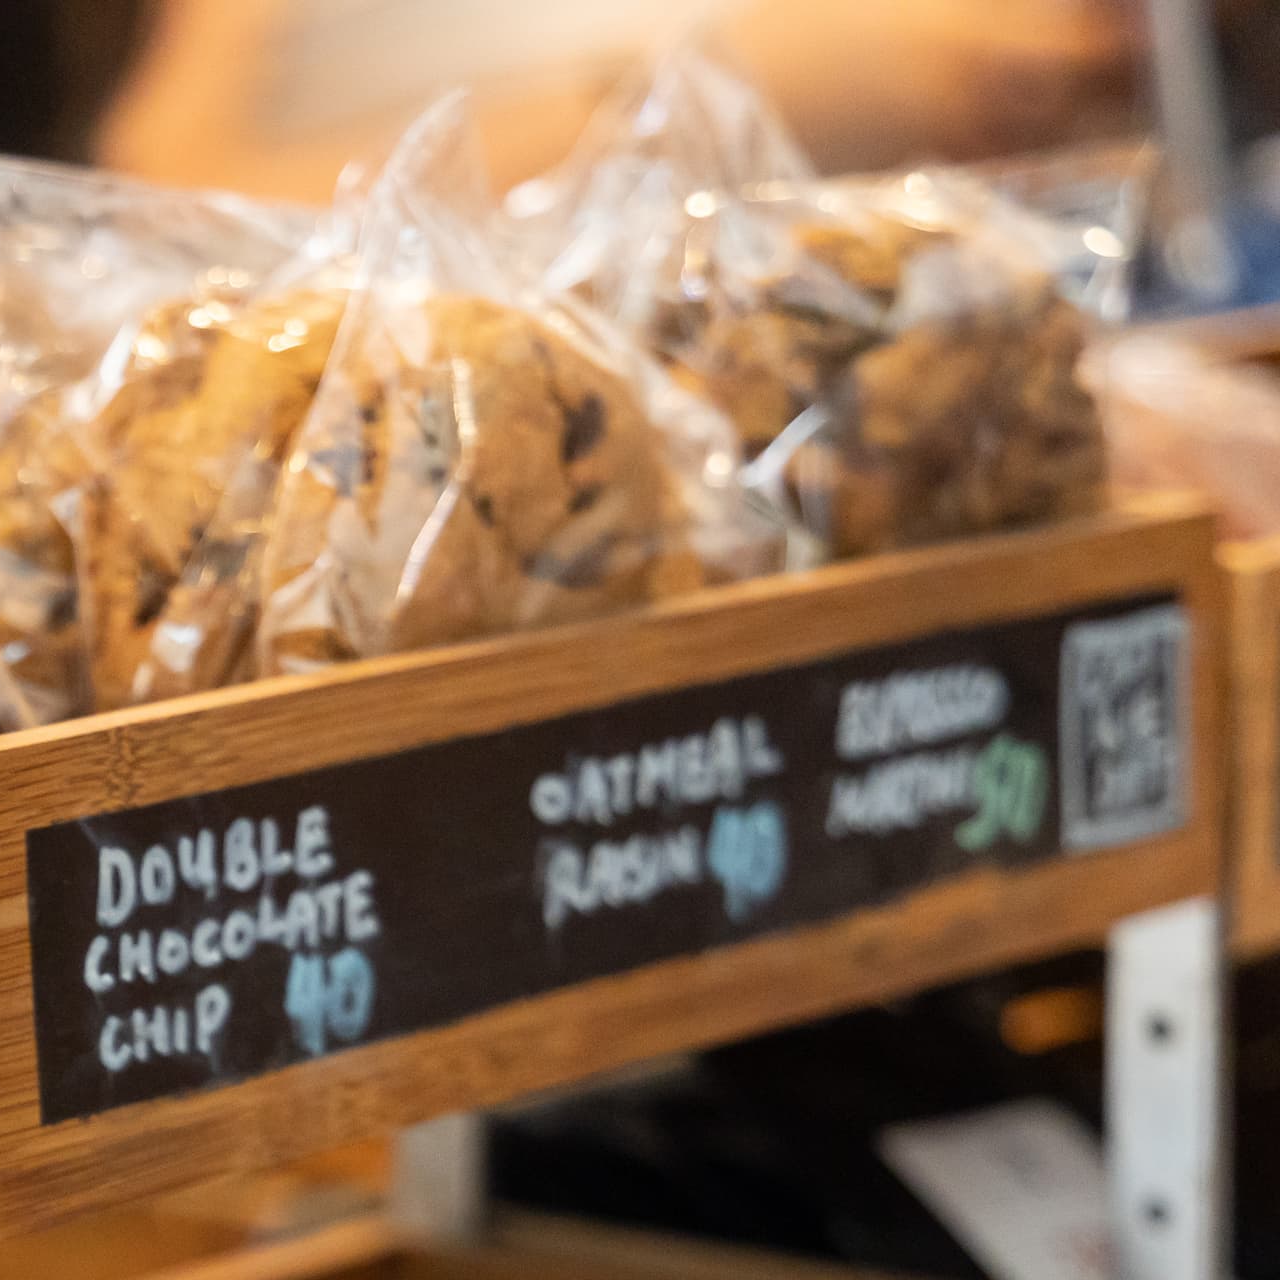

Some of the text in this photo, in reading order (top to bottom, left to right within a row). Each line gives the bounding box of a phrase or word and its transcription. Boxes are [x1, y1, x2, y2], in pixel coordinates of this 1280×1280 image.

[530, 716, 782, 827] OATMEAL
[96, 805, 336, 928] DOUBLE
[83, 870, 381, 994] CHOCOLATE
[99, 947, 378, 1072] CHIP 40
